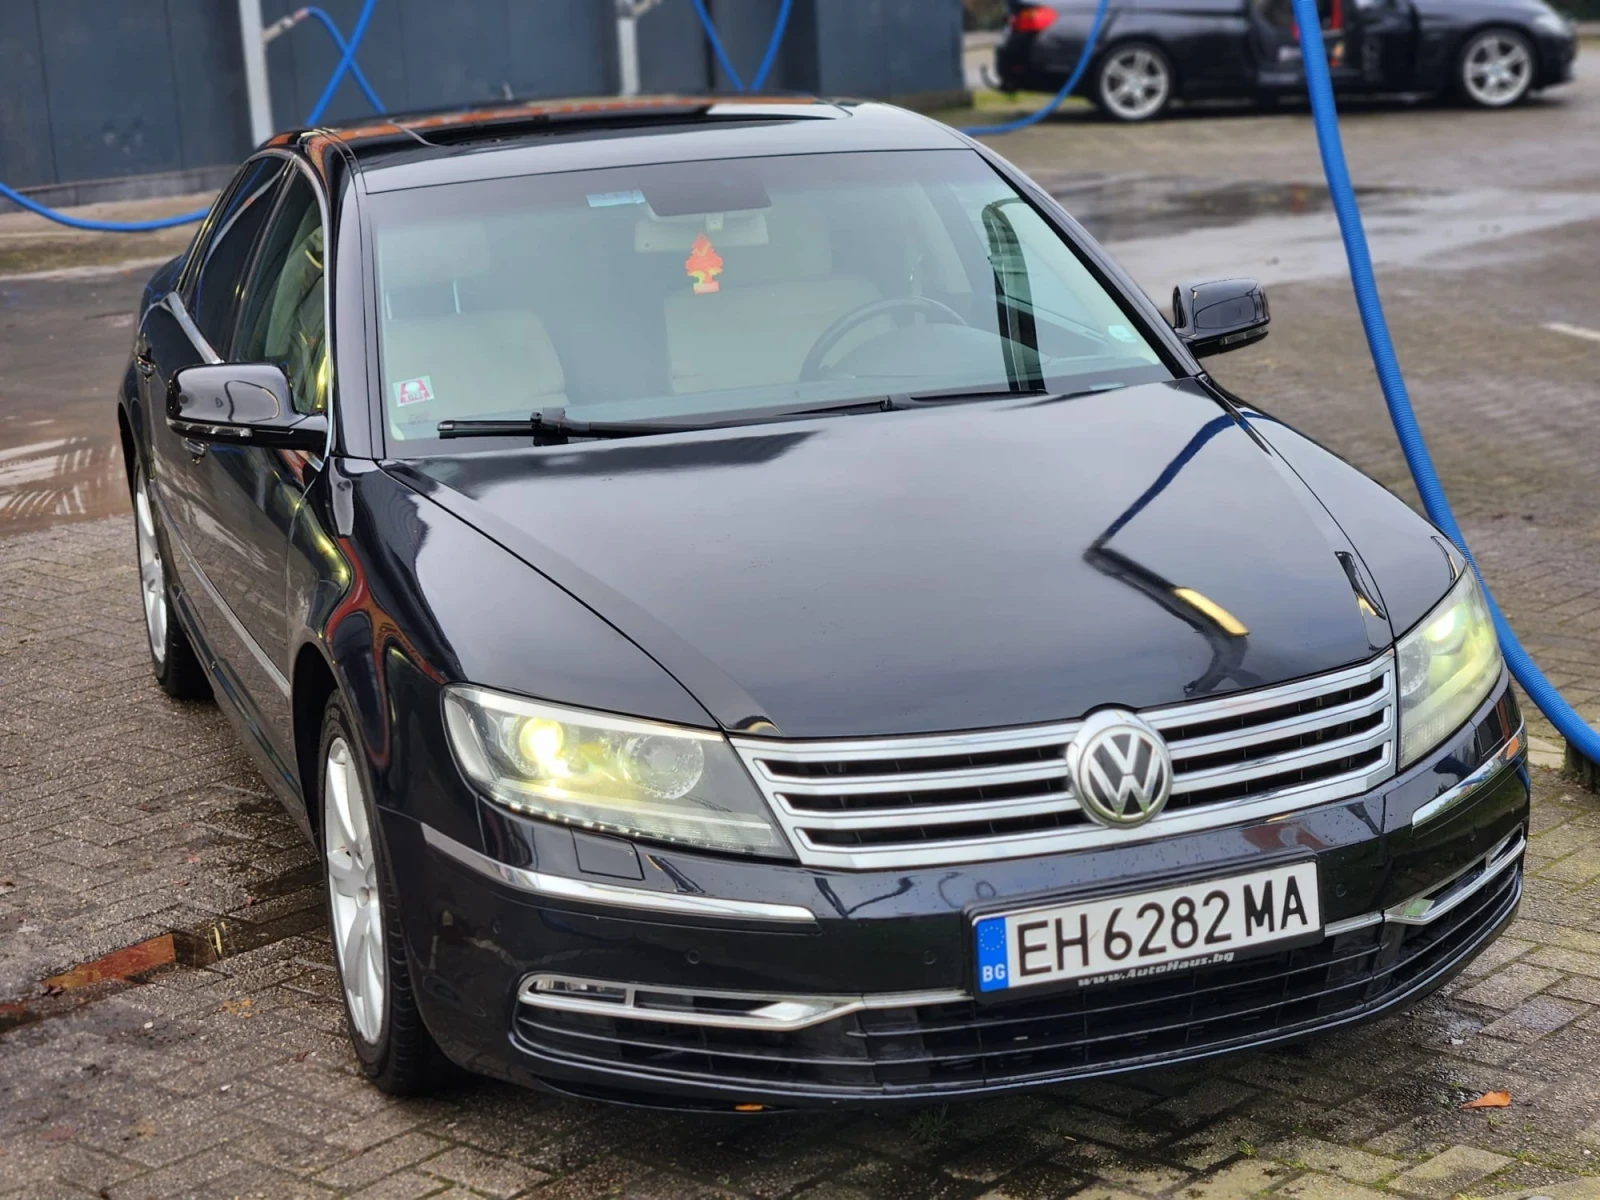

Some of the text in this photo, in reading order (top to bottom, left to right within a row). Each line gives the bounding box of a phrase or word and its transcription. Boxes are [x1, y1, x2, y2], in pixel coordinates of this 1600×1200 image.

[1082, 727, 1165, 818] VW
[982, 964, 1006, 982] BG
[1078, 952, 1235, 986] www.AutoHaus.bg
